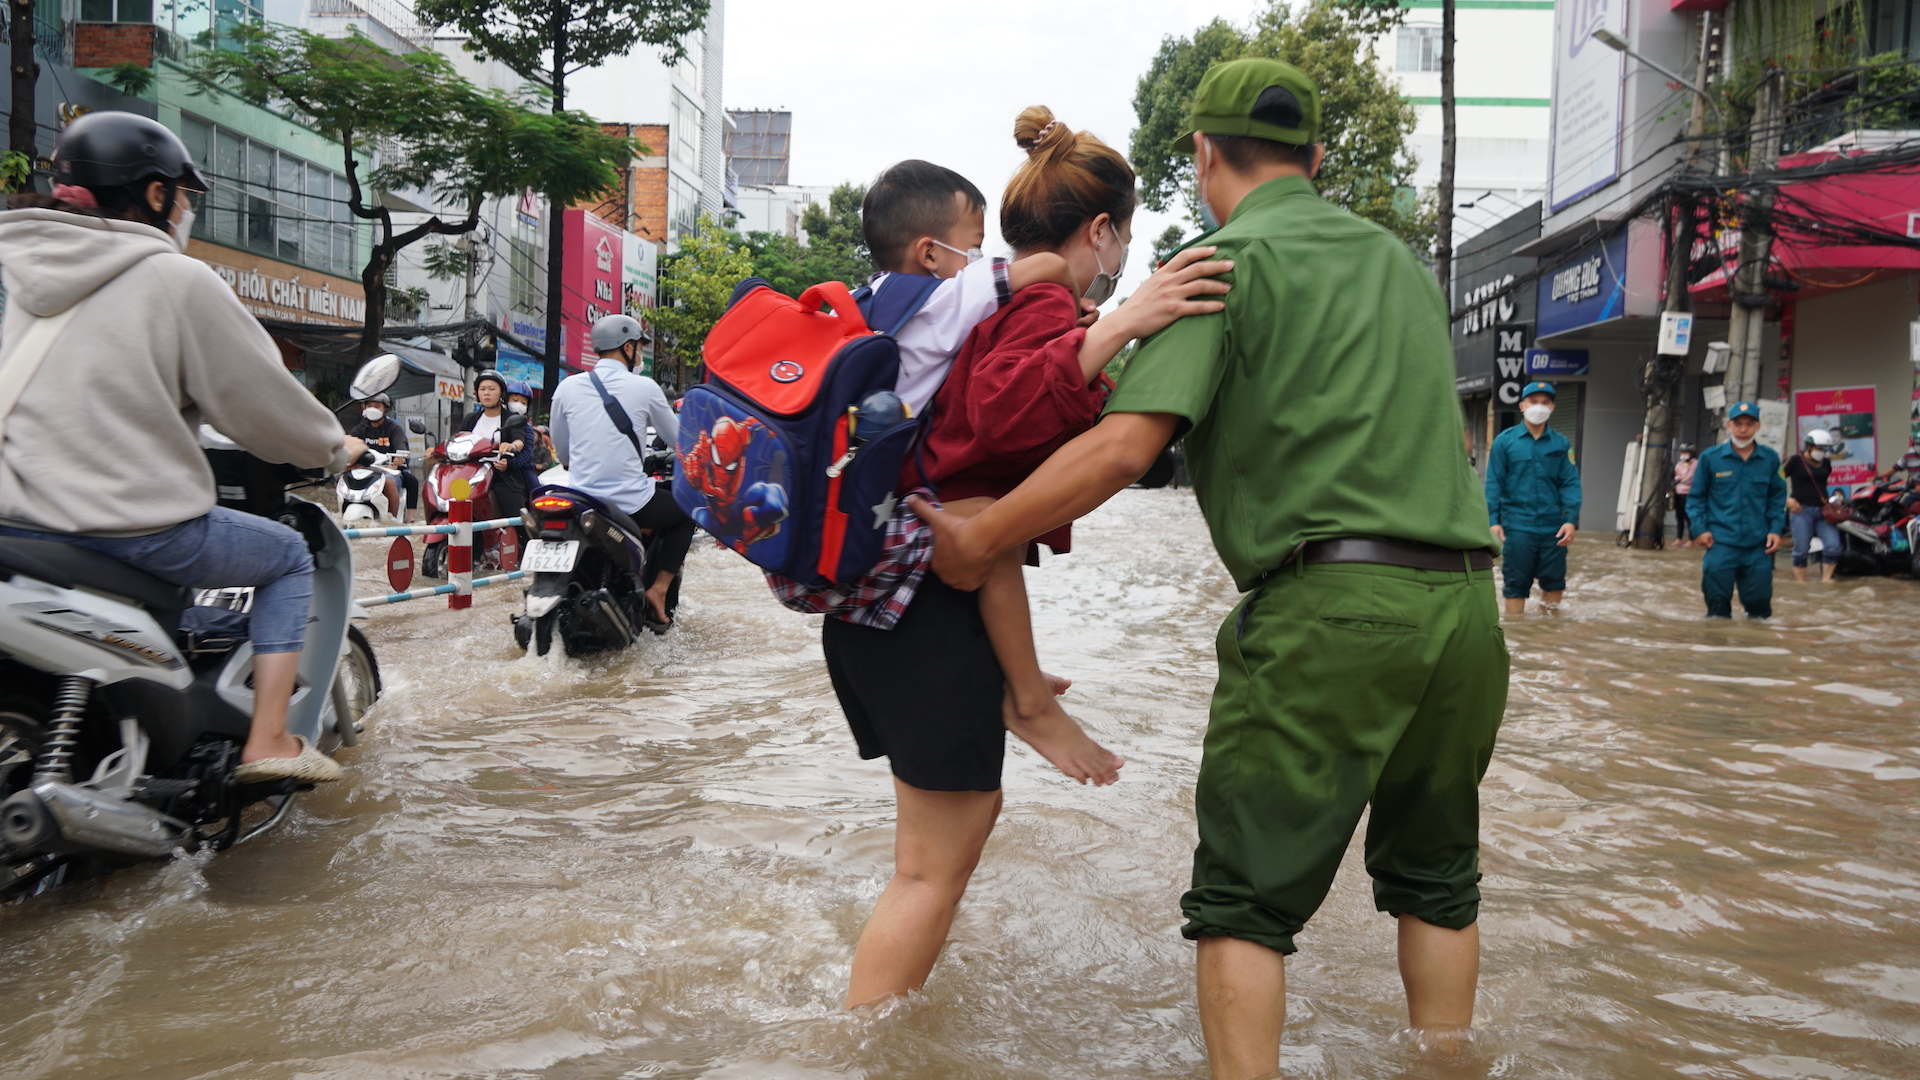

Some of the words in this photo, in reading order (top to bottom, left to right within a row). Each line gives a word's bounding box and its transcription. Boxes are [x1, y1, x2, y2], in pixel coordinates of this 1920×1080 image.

[237, 267, 268, 302] HÓA
[270, 275, 307, 310] CHẤT
[308, 283, 338, 317] MIỀN
[340, 296, 366, 323] NAM
[594, 279, 613, 302] Nhà
[1497, 330, 1525, 405] MWC
[606, 525, 625, 544] YAMAHA
[534, 541, 569, 556] 95-E1
[526, 556, 571, 570] 162.44
